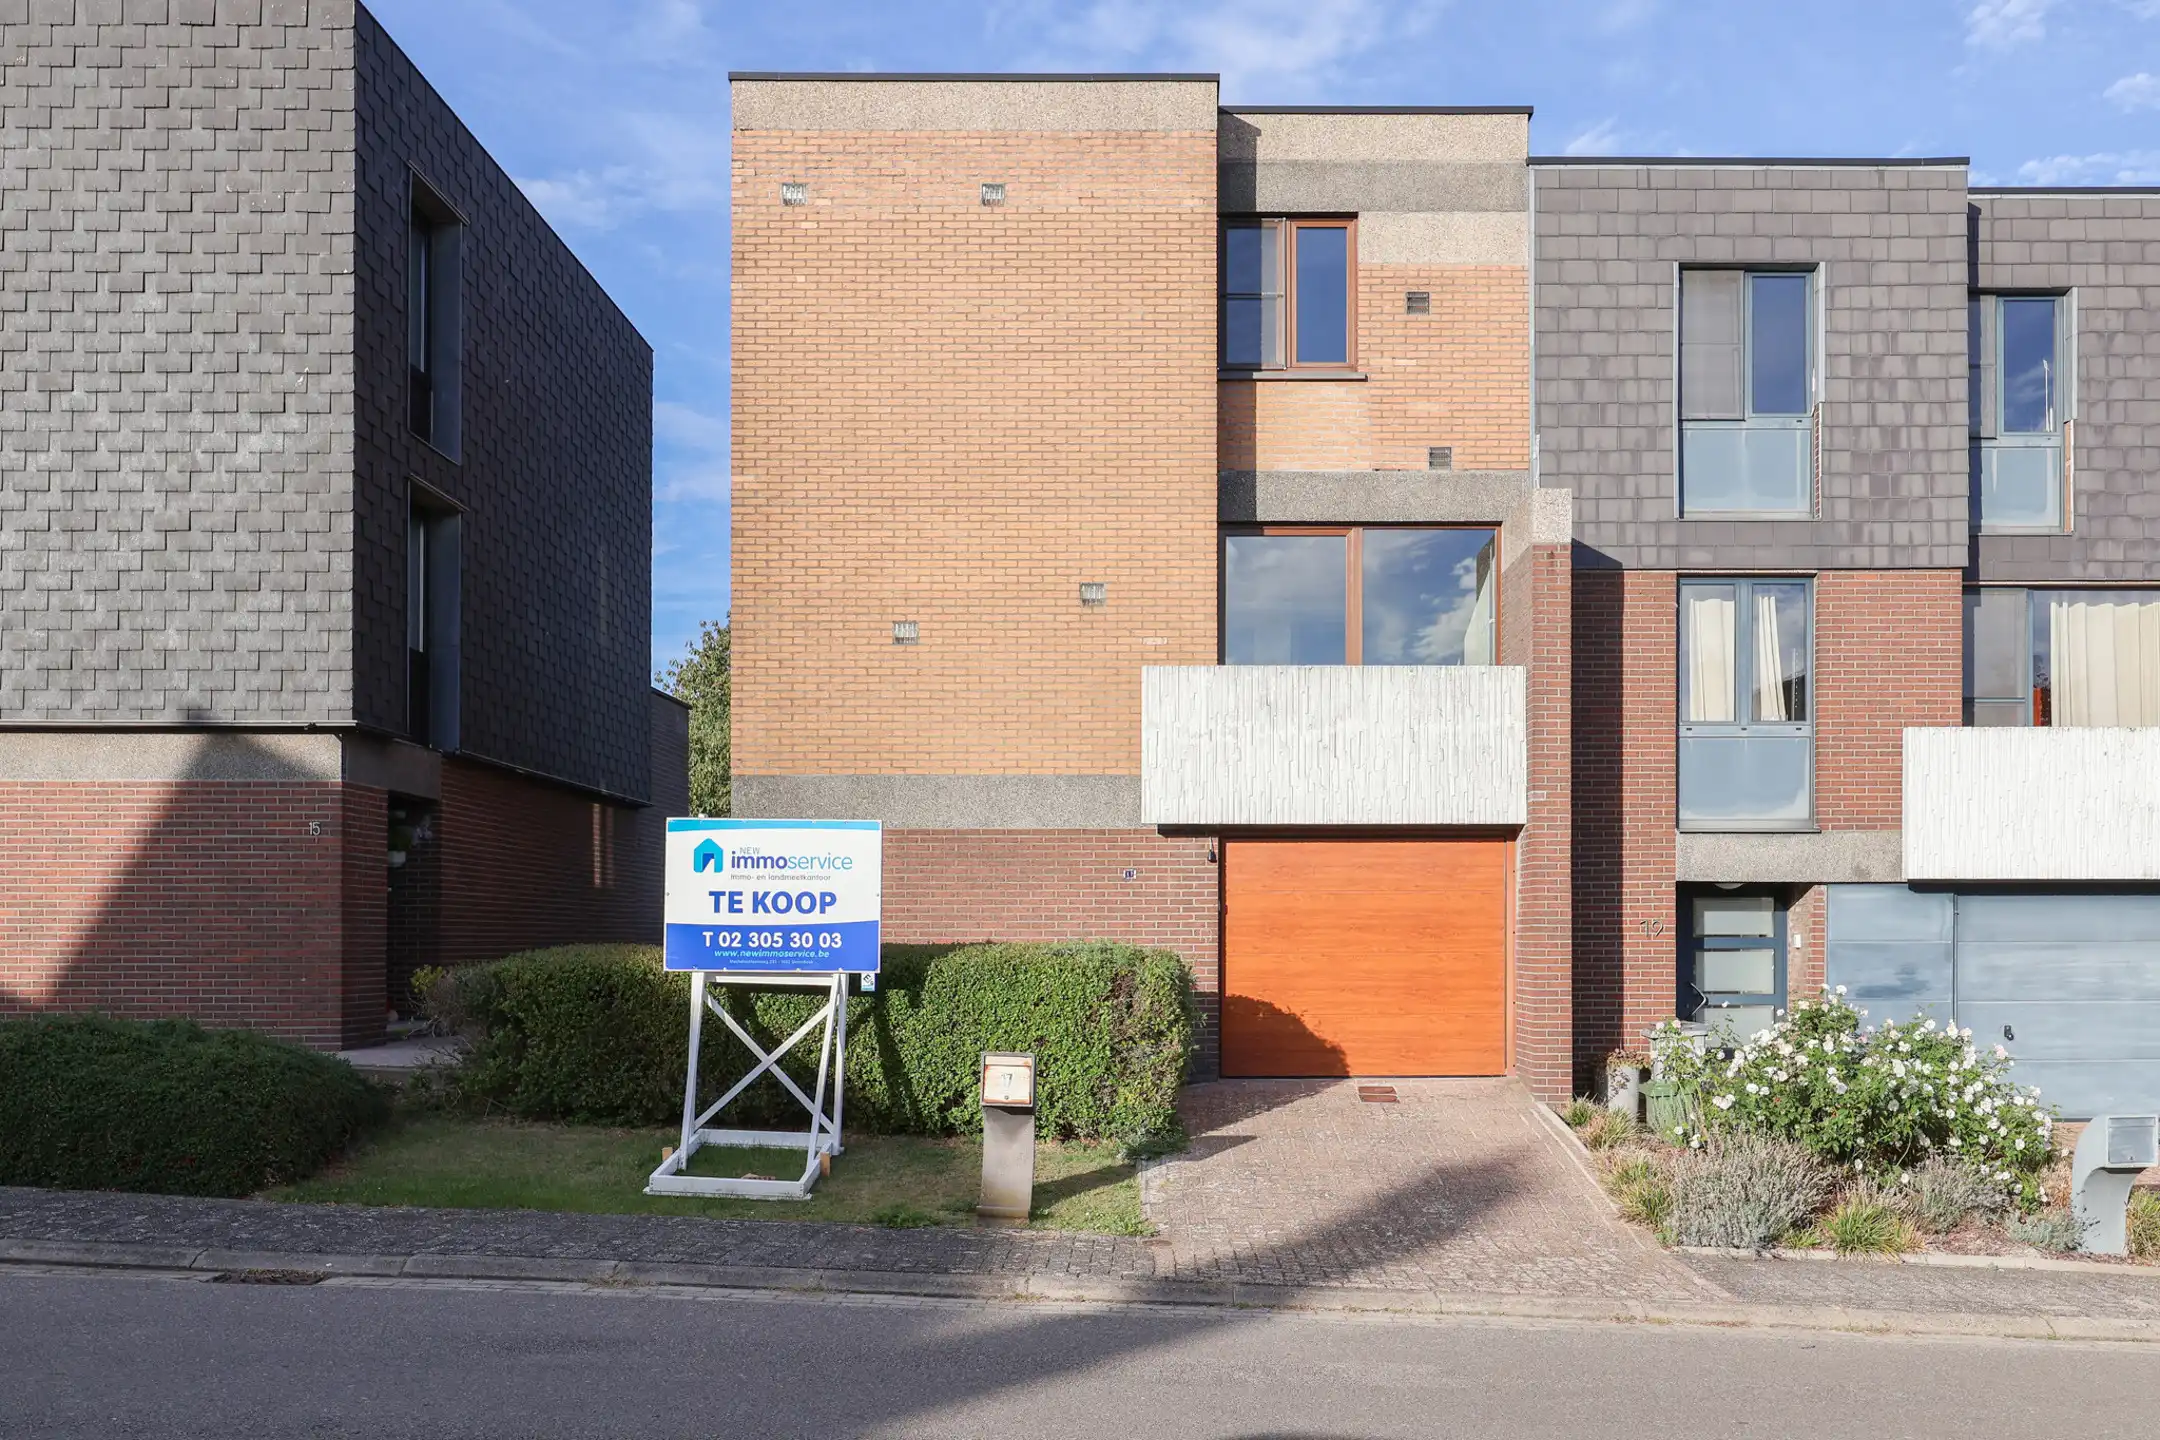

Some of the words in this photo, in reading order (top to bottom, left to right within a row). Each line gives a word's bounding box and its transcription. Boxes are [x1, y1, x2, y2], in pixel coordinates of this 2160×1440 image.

[309, 821, 321, 836] 15
[739, 846, 760, 855] NEW
[731, 850, 853, 870] immoservice
[708, 890, 744, 914] TE
[752, 891, 838, 915] KOOP
[1640, 919, 1664, 937] 19
[702, 931, 713, 948] T
[718, 931, 742, 948] 02
[748, 931, 783, 948] 305
[789, 932, 814, 948] 30
[819, 932, 843, 948] 03
[714, 949, 830, 958] www.newimmoservice.be
